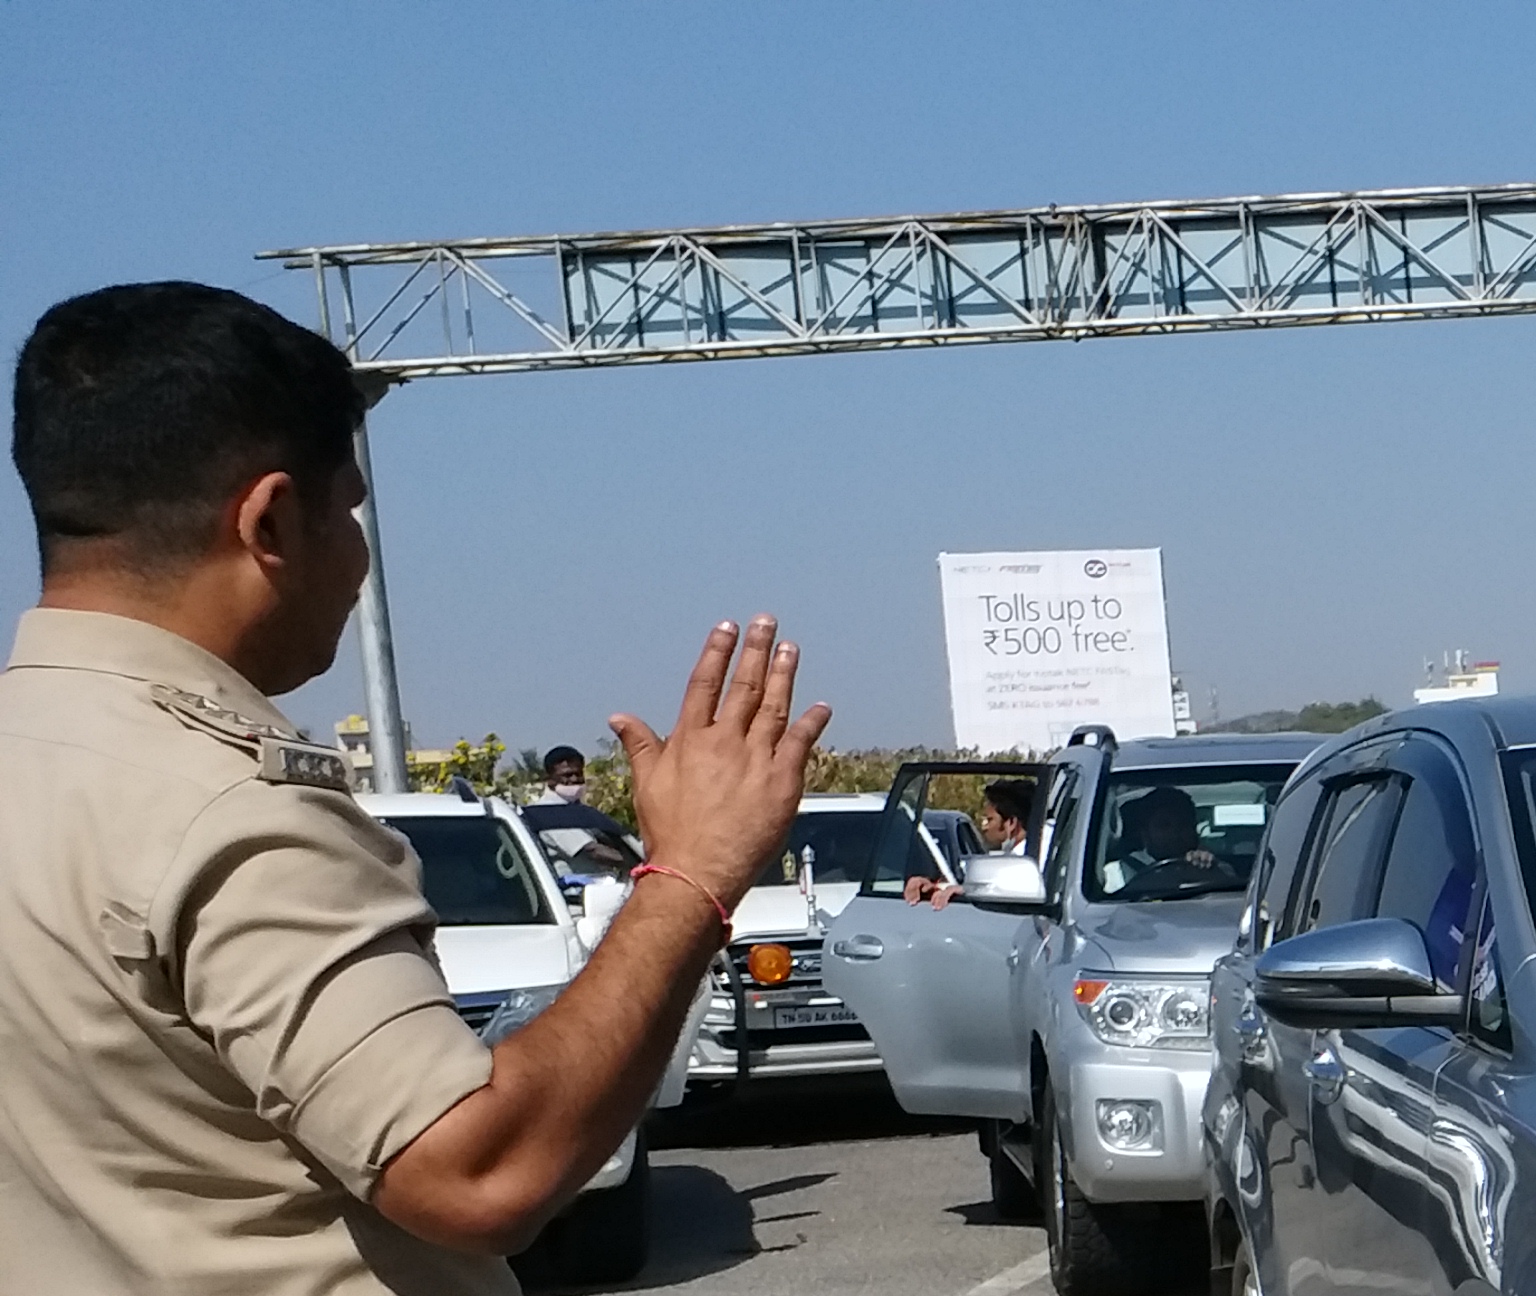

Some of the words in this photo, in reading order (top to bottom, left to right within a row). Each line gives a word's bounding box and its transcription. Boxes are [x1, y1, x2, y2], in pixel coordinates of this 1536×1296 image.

[978, 593, 1041, 623] Tolls
[1048, 598, 1085, 627] up
[1091, 595, 1122, 620] to
[983, 626, 1062, 655] ₹500
